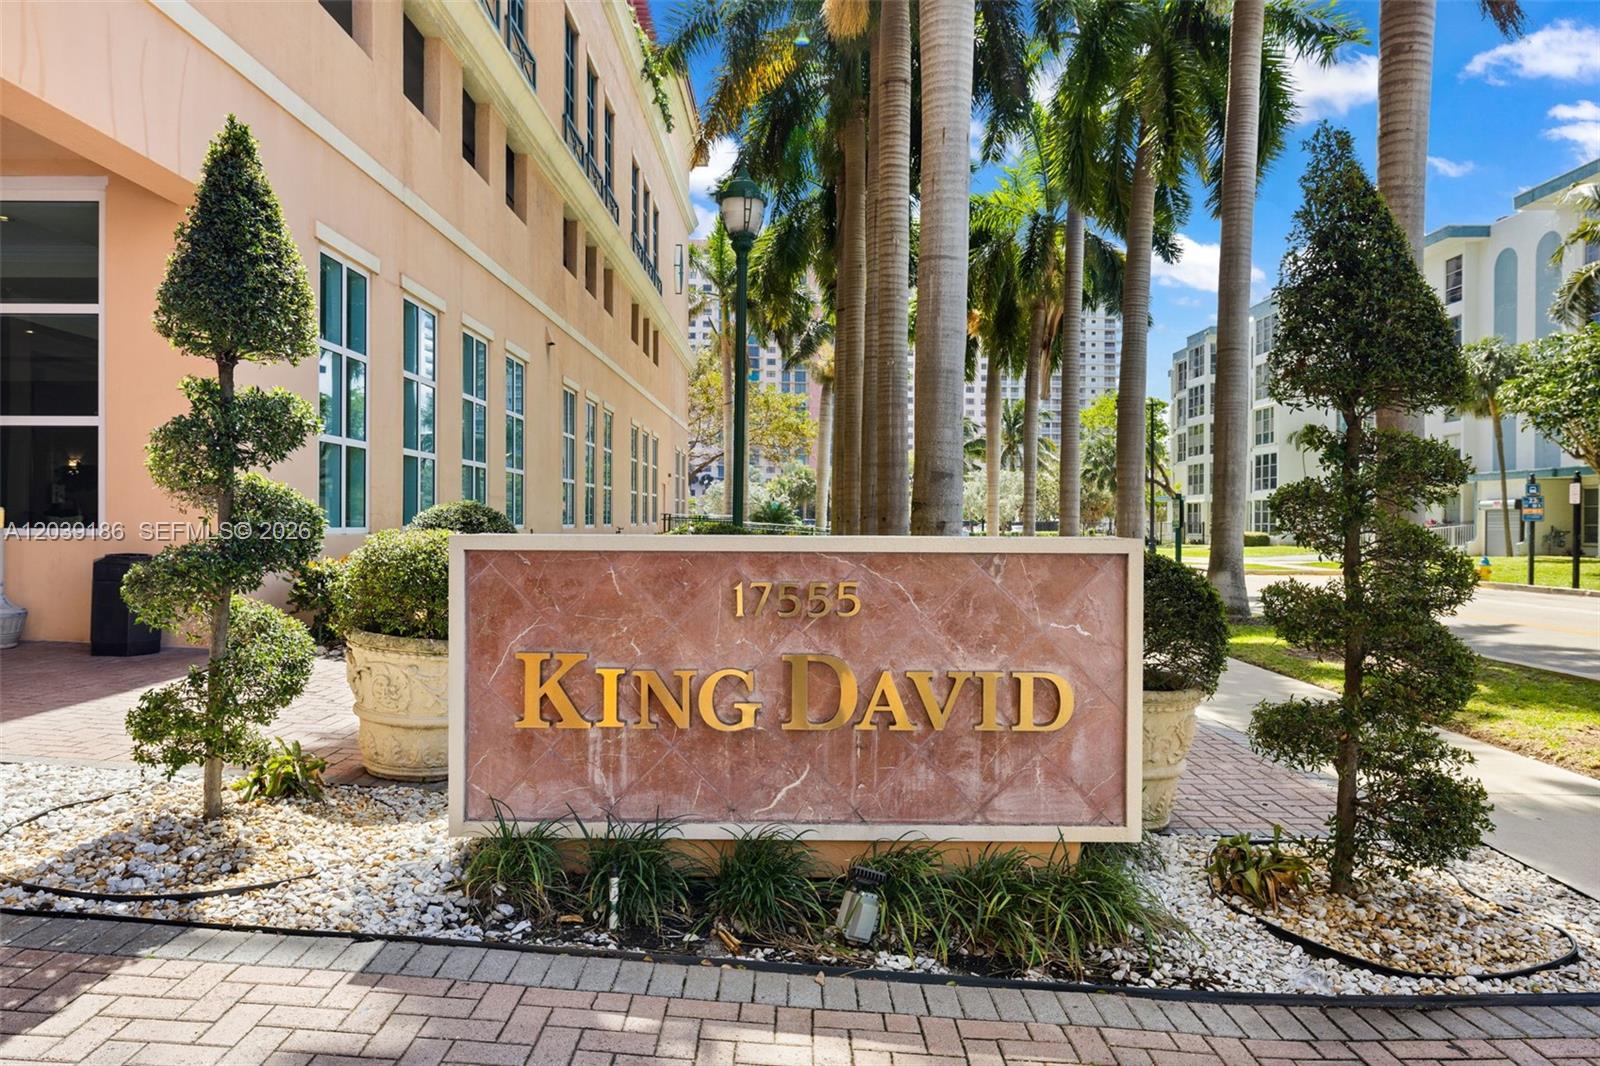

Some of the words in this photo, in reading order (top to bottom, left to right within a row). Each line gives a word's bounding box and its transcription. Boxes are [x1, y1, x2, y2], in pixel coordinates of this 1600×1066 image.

[733, 581, 862, 618] 17555
[514, 651, 763, 732] KING
[781, 654, 1075, 732] DAVID
